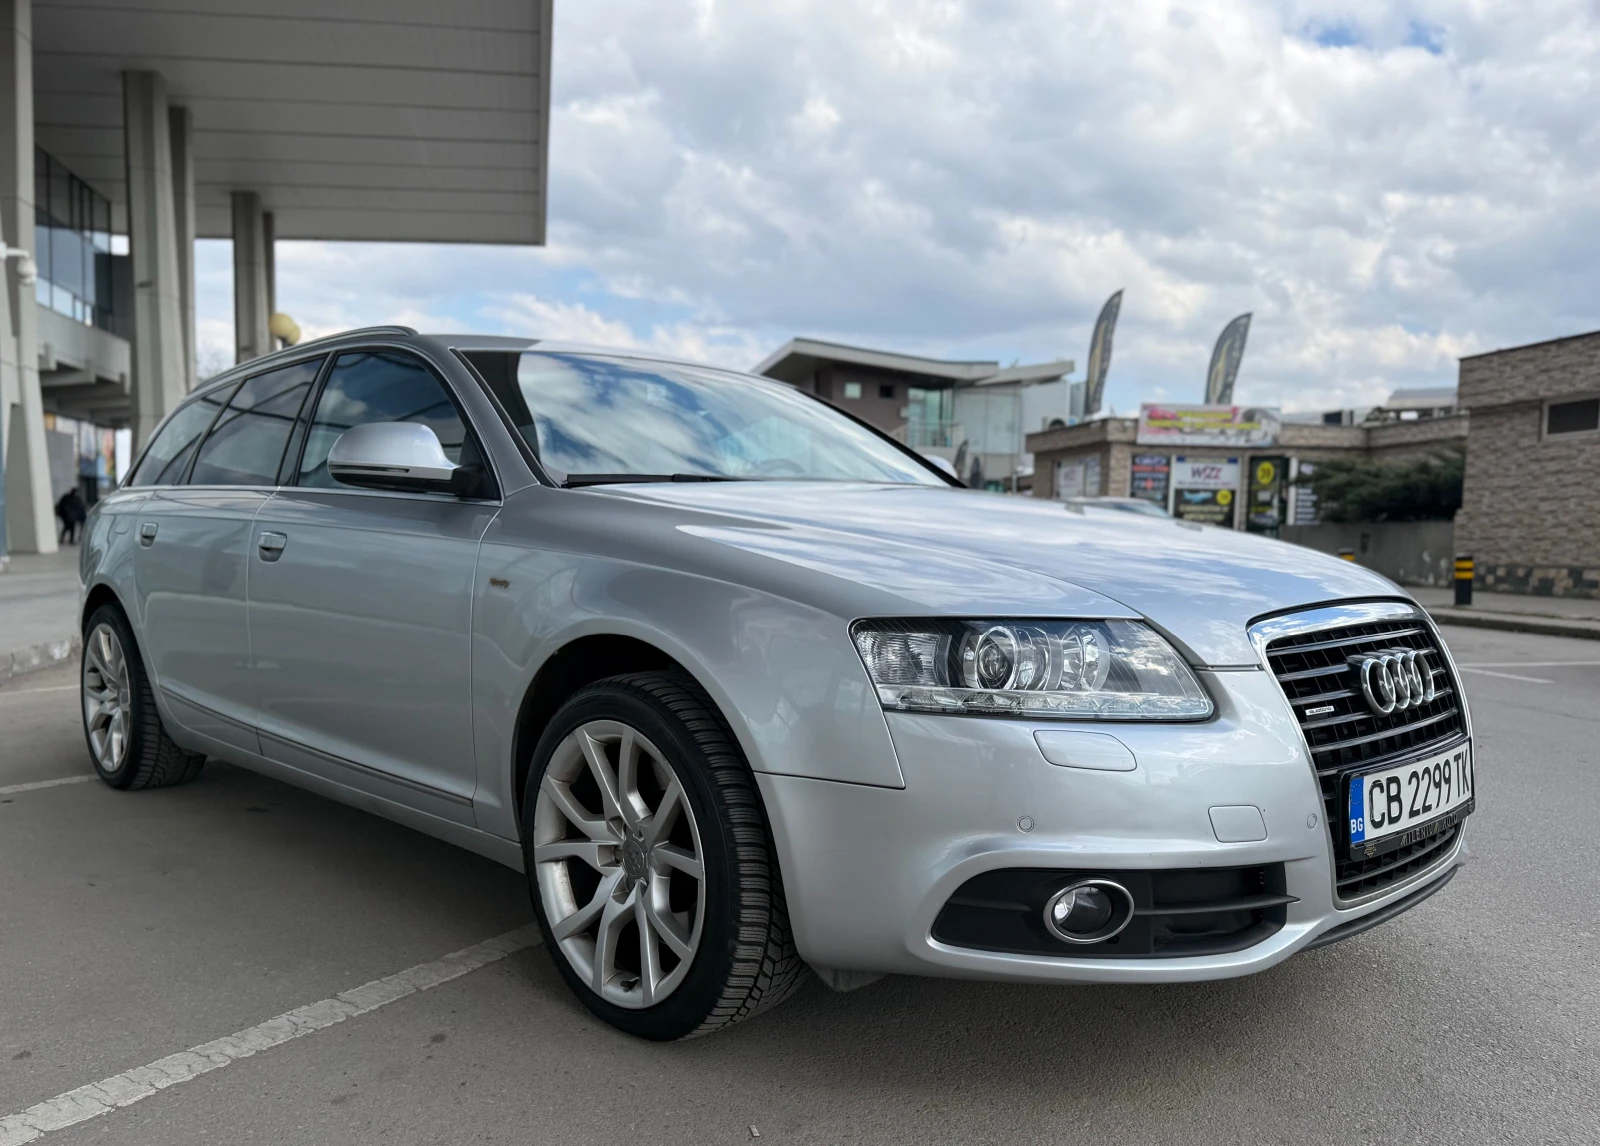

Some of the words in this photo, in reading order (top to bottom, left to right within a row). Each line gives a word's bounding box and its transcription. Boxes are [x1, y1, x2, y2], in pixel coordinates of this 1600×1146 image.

[1368, 775, 1403, 829] CB
[1407, 758, 1452, 819] 2299
[1453, 748, 1469, 798] TK
[1350, 817, 1364, 834] BG
